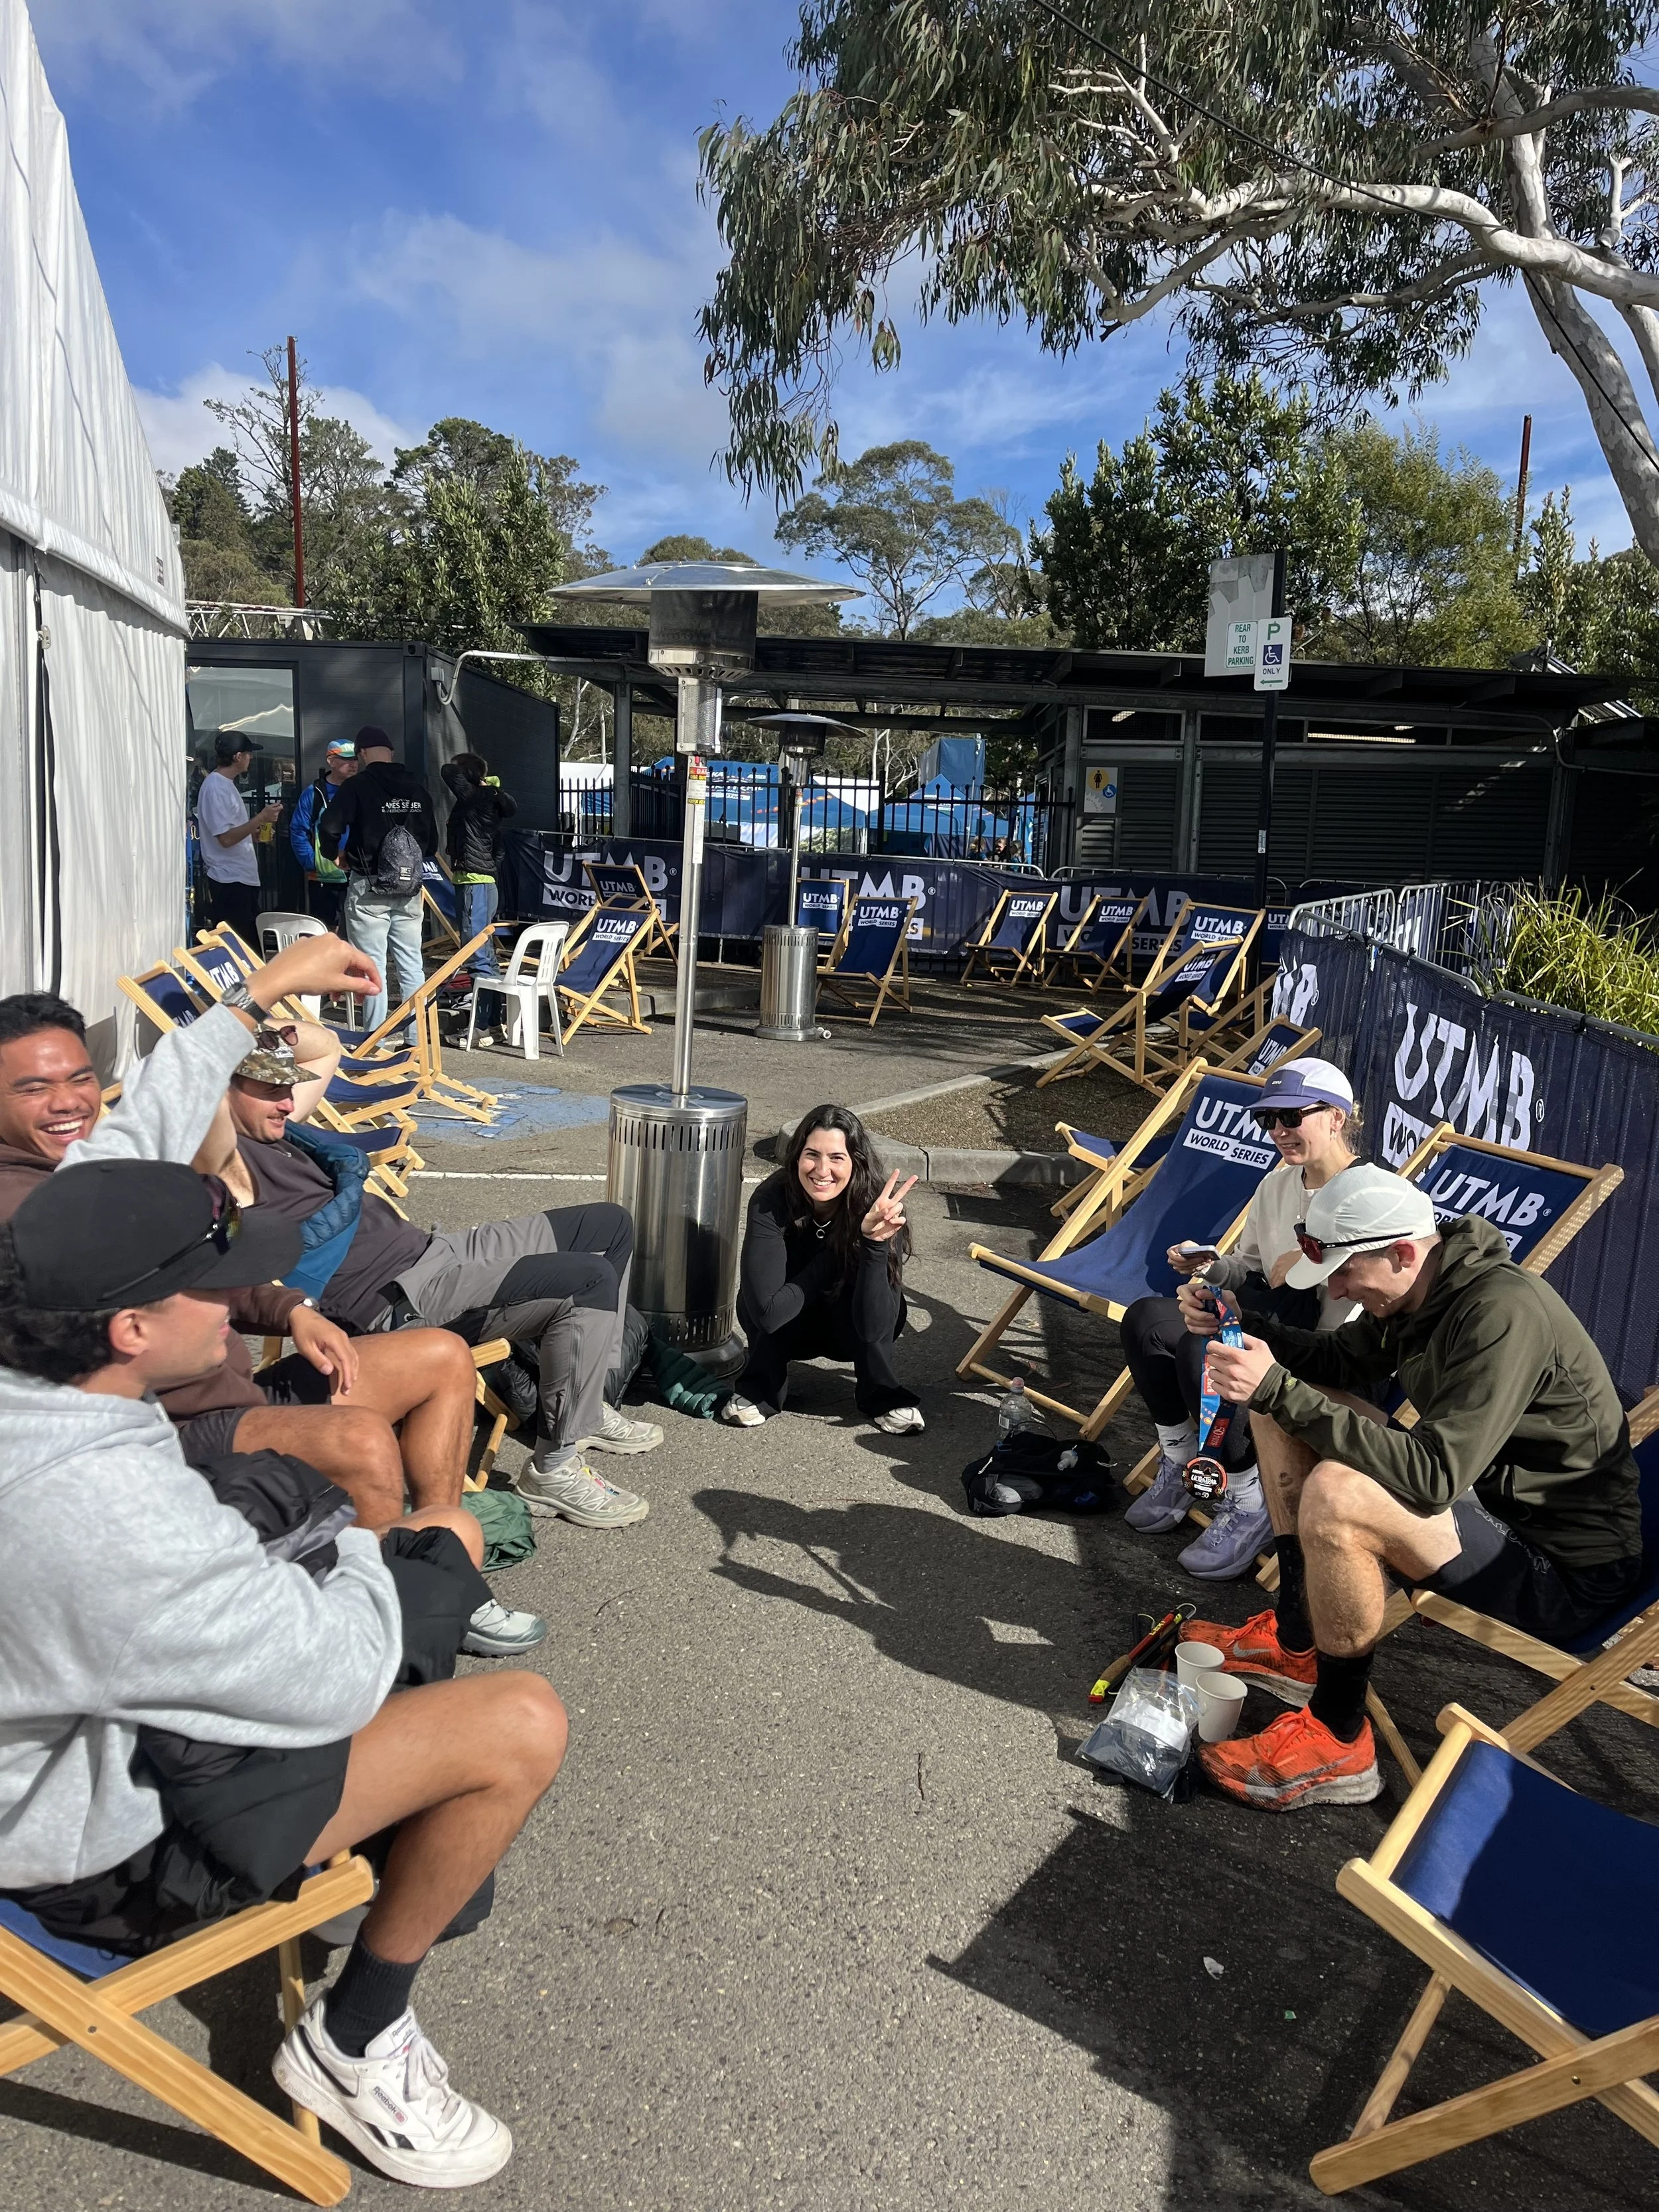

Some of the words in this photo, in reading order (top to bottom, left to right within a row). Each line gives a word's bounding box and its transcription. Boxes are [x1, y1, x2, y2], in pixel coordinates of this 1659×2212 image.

[1235, 624, 1251, 632] REAR
[1267, 623, 1281, 640] P
[1234, 646, 1250, 654] KERB
[1228, 656, 1254, 666] PARKING
[600, 881, 636, 893] UTMB
[803, 893, 839, 903] UTMB
[1011, 899, 1044, 911] UTMB
[1102, 905, 1133, 917] UTMB
[859, 906, 900, 919] UTMB
[597, 918, 636, 934] UTMB
[1194, 916, 1244, 934] UTMB
[1190, 1133, 1230, 1151] WORLD
[1230, 1147, 1270, 1165] SERIES
[1149, 1621, 1166, 1635] LEKI
[373, 2086, 397, 2115] Reebok
